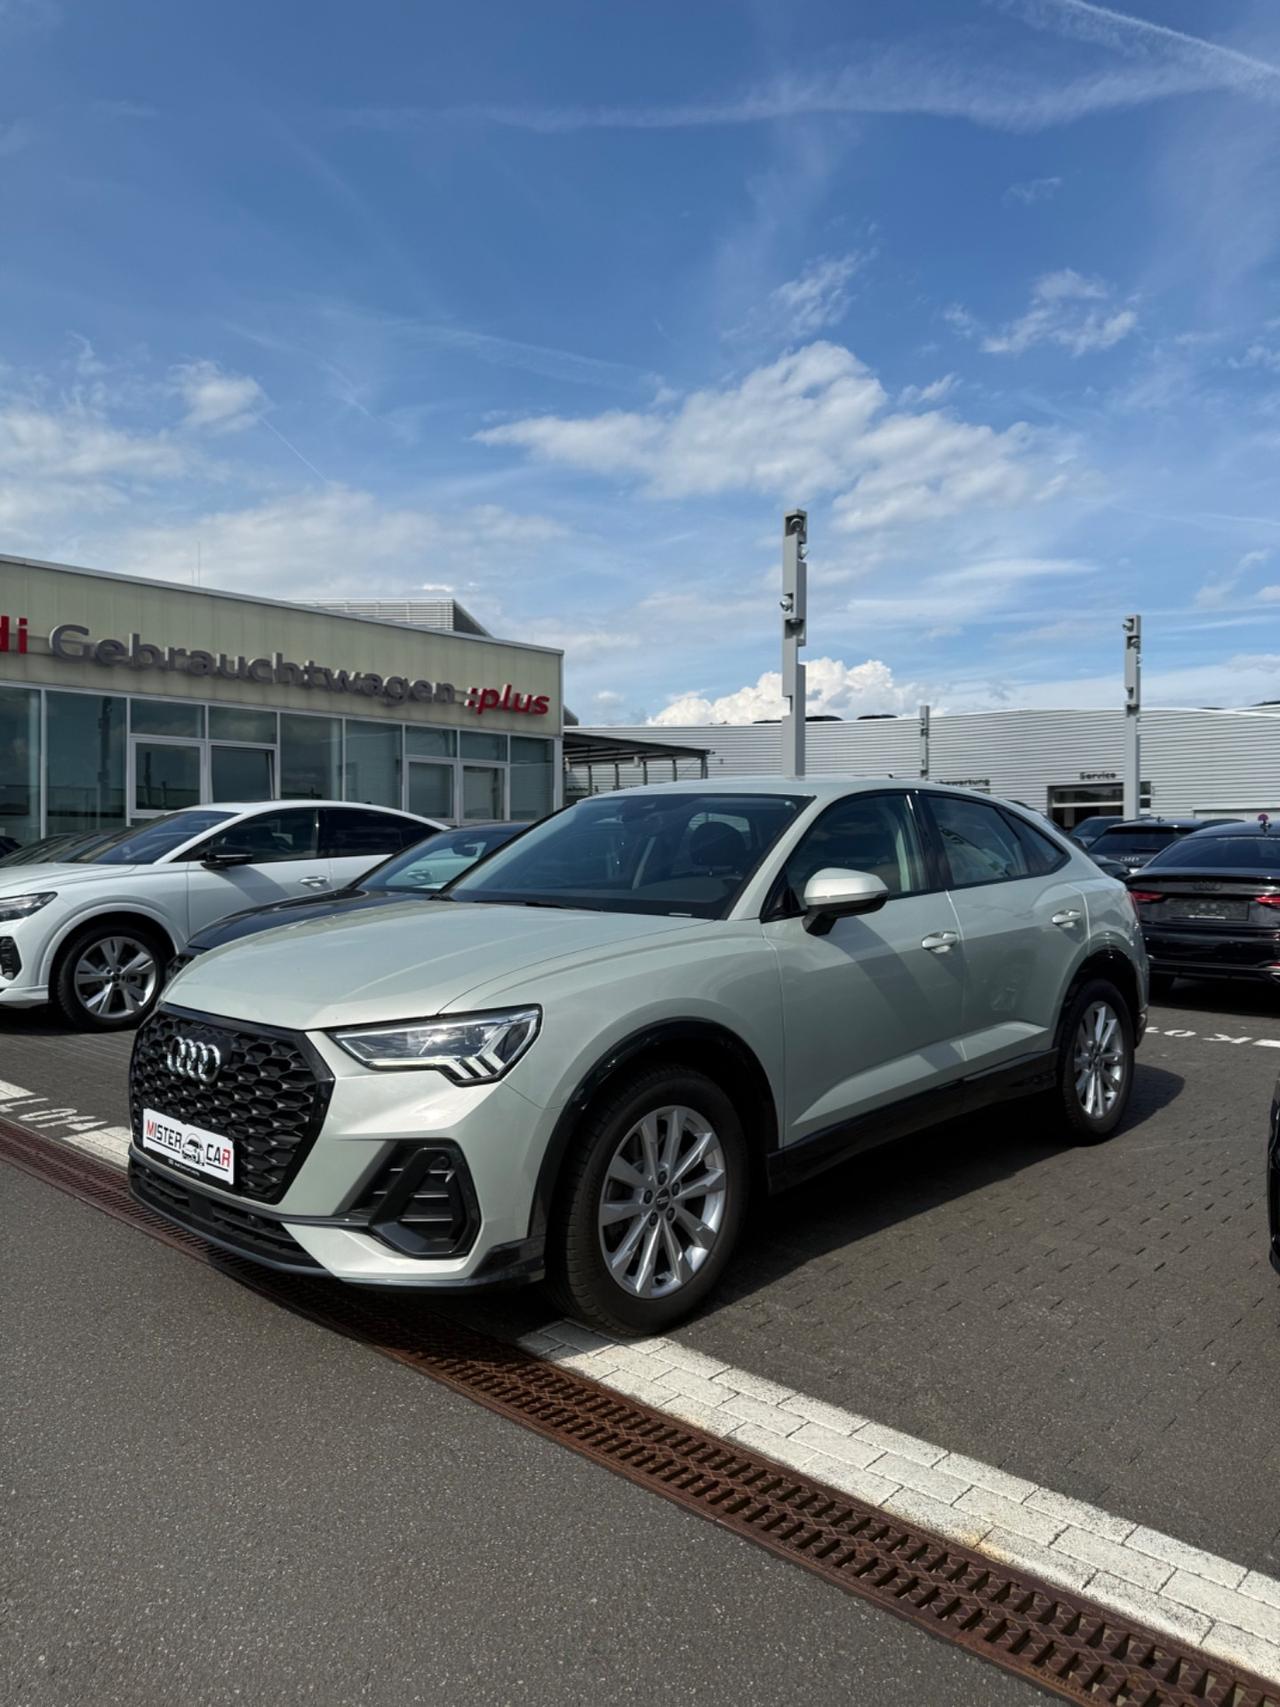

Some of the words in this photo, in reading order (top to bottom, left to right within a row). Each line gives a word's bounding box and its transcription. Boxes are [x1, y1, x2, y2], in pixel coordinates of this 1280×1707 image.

[49, 624, 456, 706] Gebrauchtwagen
[1080, 772, 1116, 780] Service
[146, 1119, 182, 1150] MISTER
[206, 1143, 232, 1168] CAR
